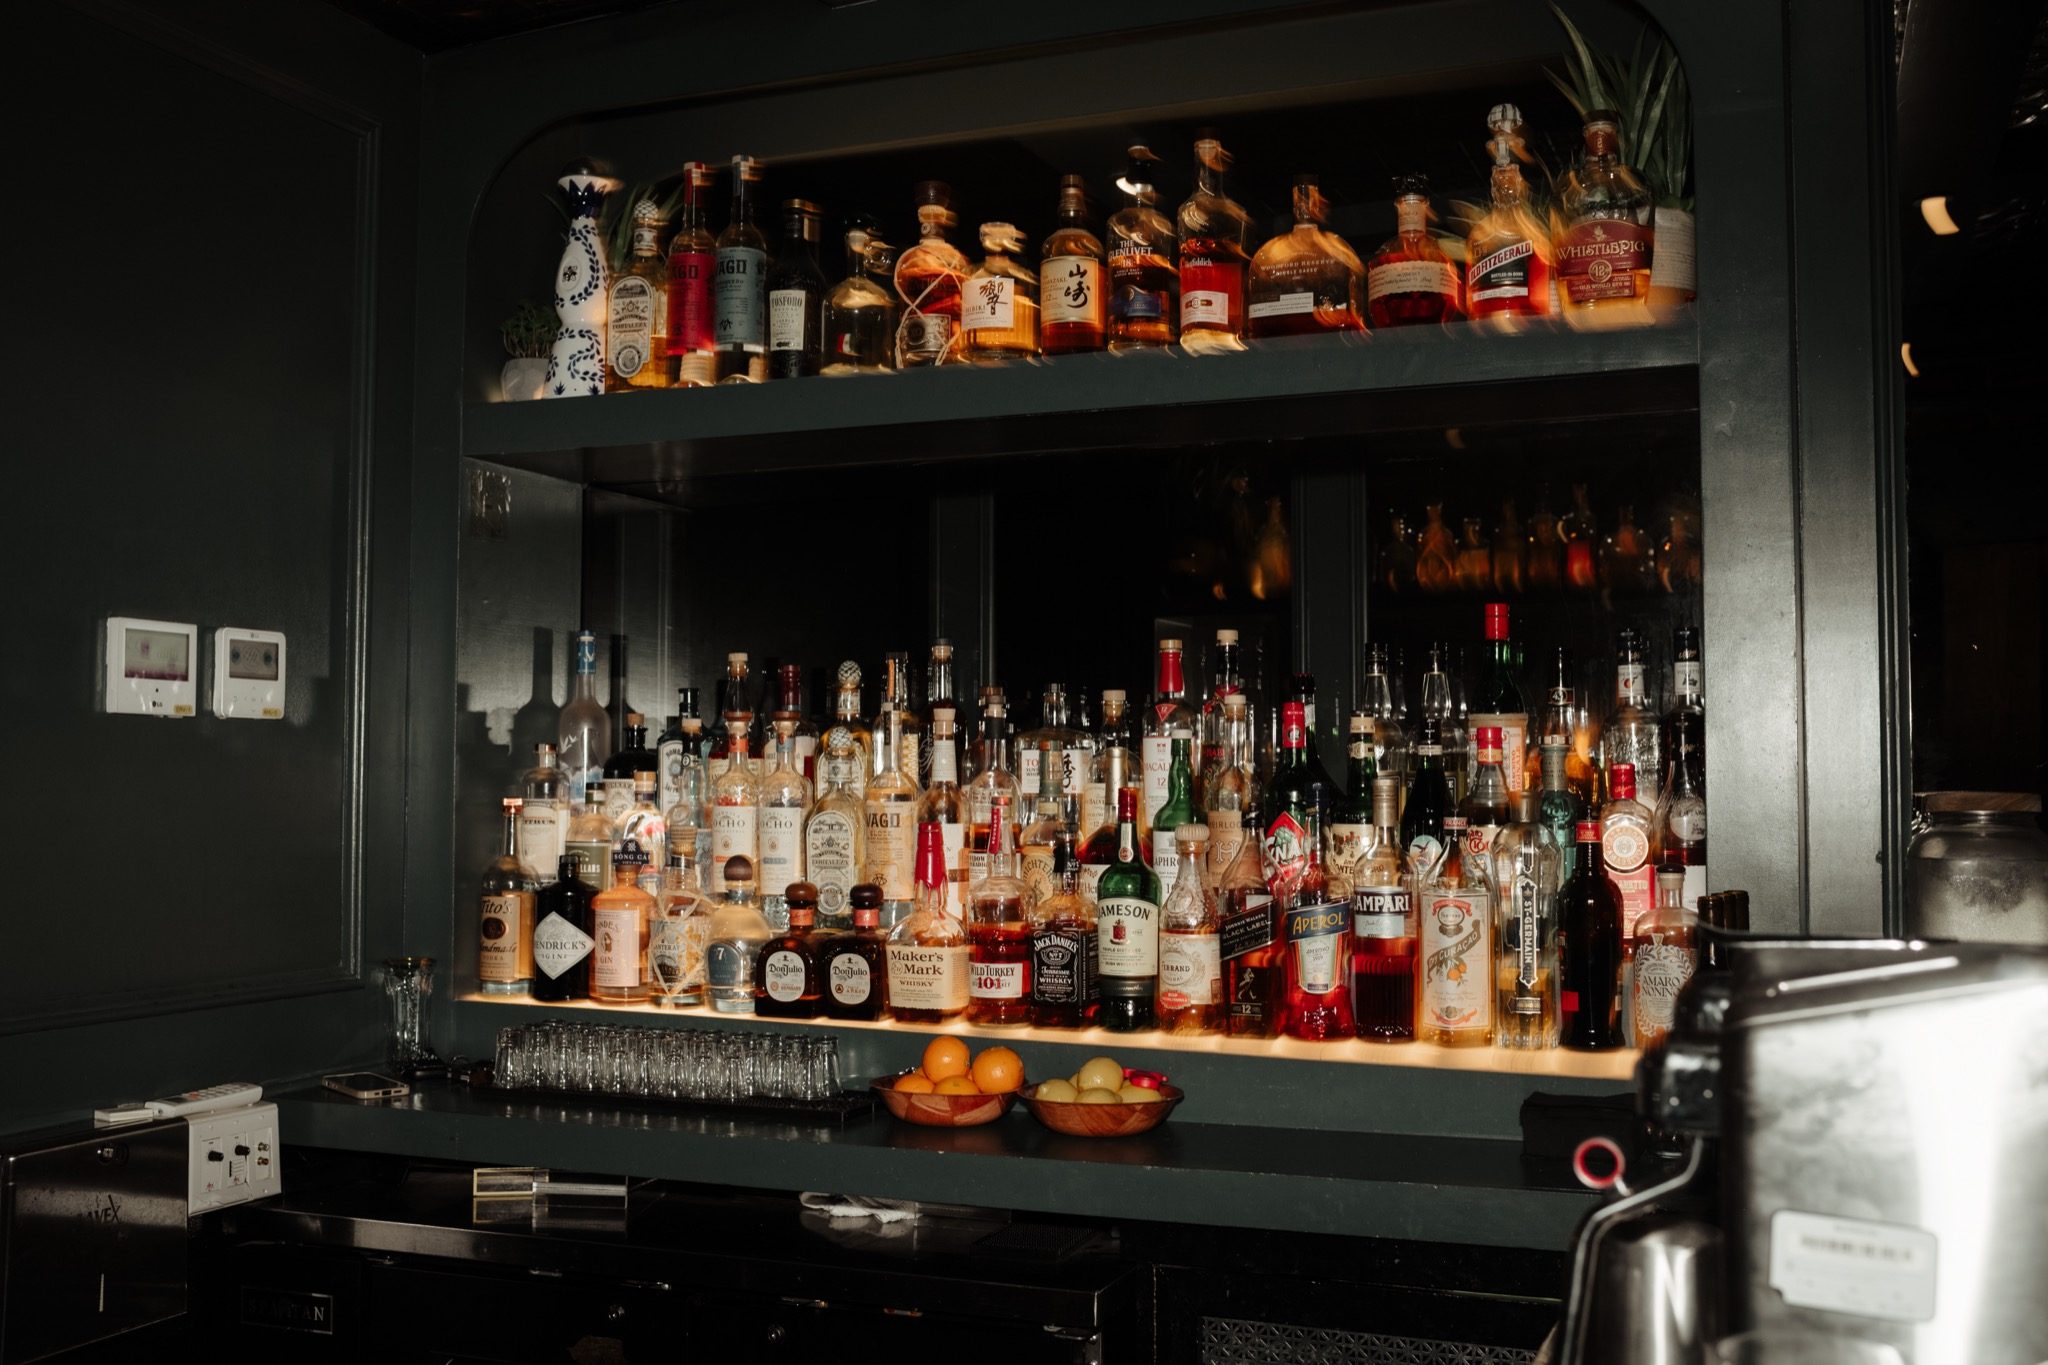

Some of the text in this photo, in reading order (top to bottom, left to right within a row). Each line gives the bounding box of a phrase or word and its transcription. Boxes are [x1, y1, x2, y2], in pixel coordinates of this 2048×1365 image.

[1120, 240, 1135, 249] THE
[1108, 246, 1153, 261] GLENLIVET
[1481, 242, 1531, 272] FITZGERALD
[1156, 777, 1166, 787] 12
[481, 899, 513, 915] Tito's
[1099, 903, 1151, 921] JAMESON
[1293, 911, 1345, 935] APEROL
[1524, 900, 1533, 965] ST-GERMAIN
[480, 942, 518, 954] ndmade
[536, 940, 587, 951] ENDRICK'S
[1034, 934, 1079, 954] JACK DANIEL'S
[717, 947, 725, 961] 7
[890, 950, 944, 962] Maker's
[769, 963, 803, 977] Don Julio
[833, 965, 867, 979] Don Julio
[904, 963, 943, 976] Mark
[970, 964, 1015, 977] WILD TURKEY
[1162, 964, 1191, 973] ERRAND
[976, 976, 1002, 990] 101
[1039, 976, 1072, 985] WHISKEY
[1643, 975, 1680, 987] AMARO
[1642, 986, 1679, 998] NONINO
[1241, 1004, 1252, 1014] 12
